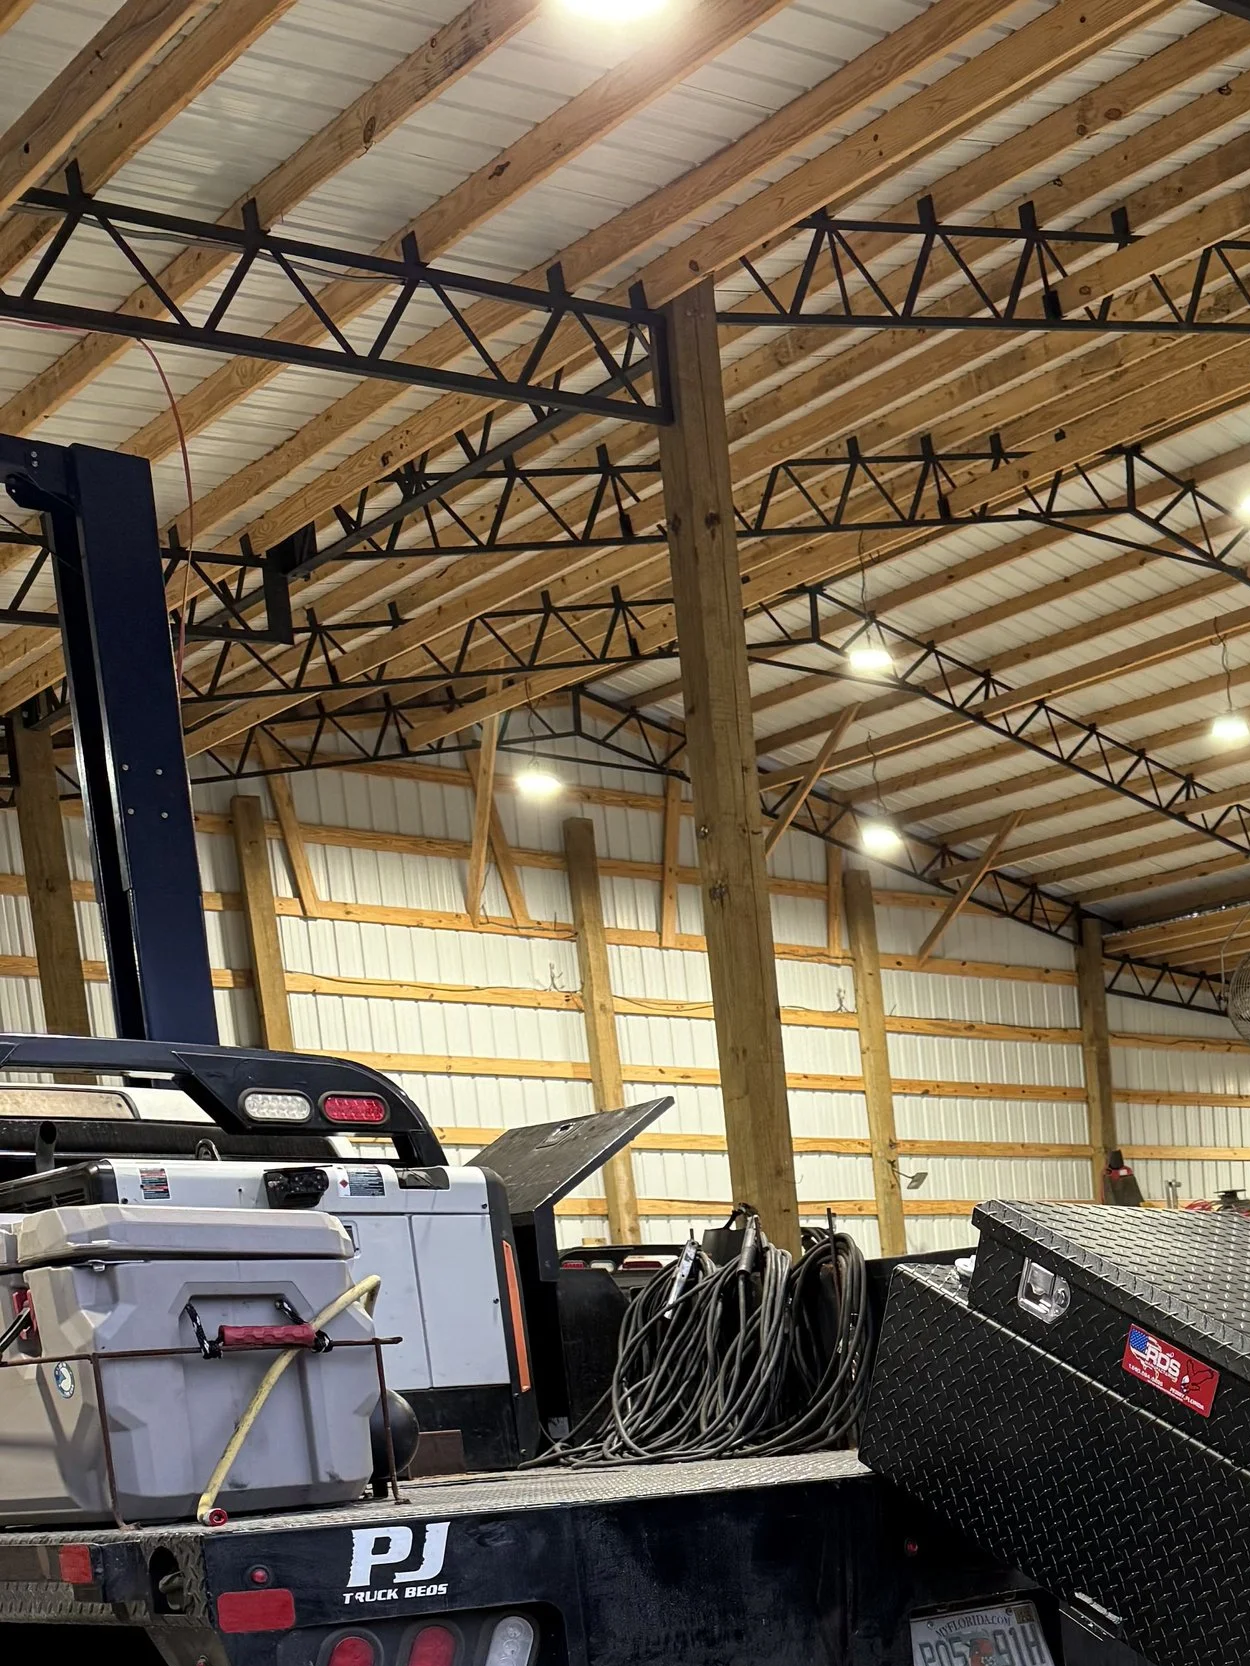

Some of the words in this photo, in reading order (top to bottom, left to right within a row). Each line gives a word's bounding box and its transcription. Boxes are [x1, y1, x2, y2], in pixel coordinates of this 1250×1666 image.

[1145, 1342, 1181, 1379] RDS
[346, 1521, 451, 1588] PJ
[342, 1588, 399, 1605] TRUCK
[404, 1583, 449, 1599] BEDS
[935, 1614, 1011, 1638] MYFLORIDA.COM
